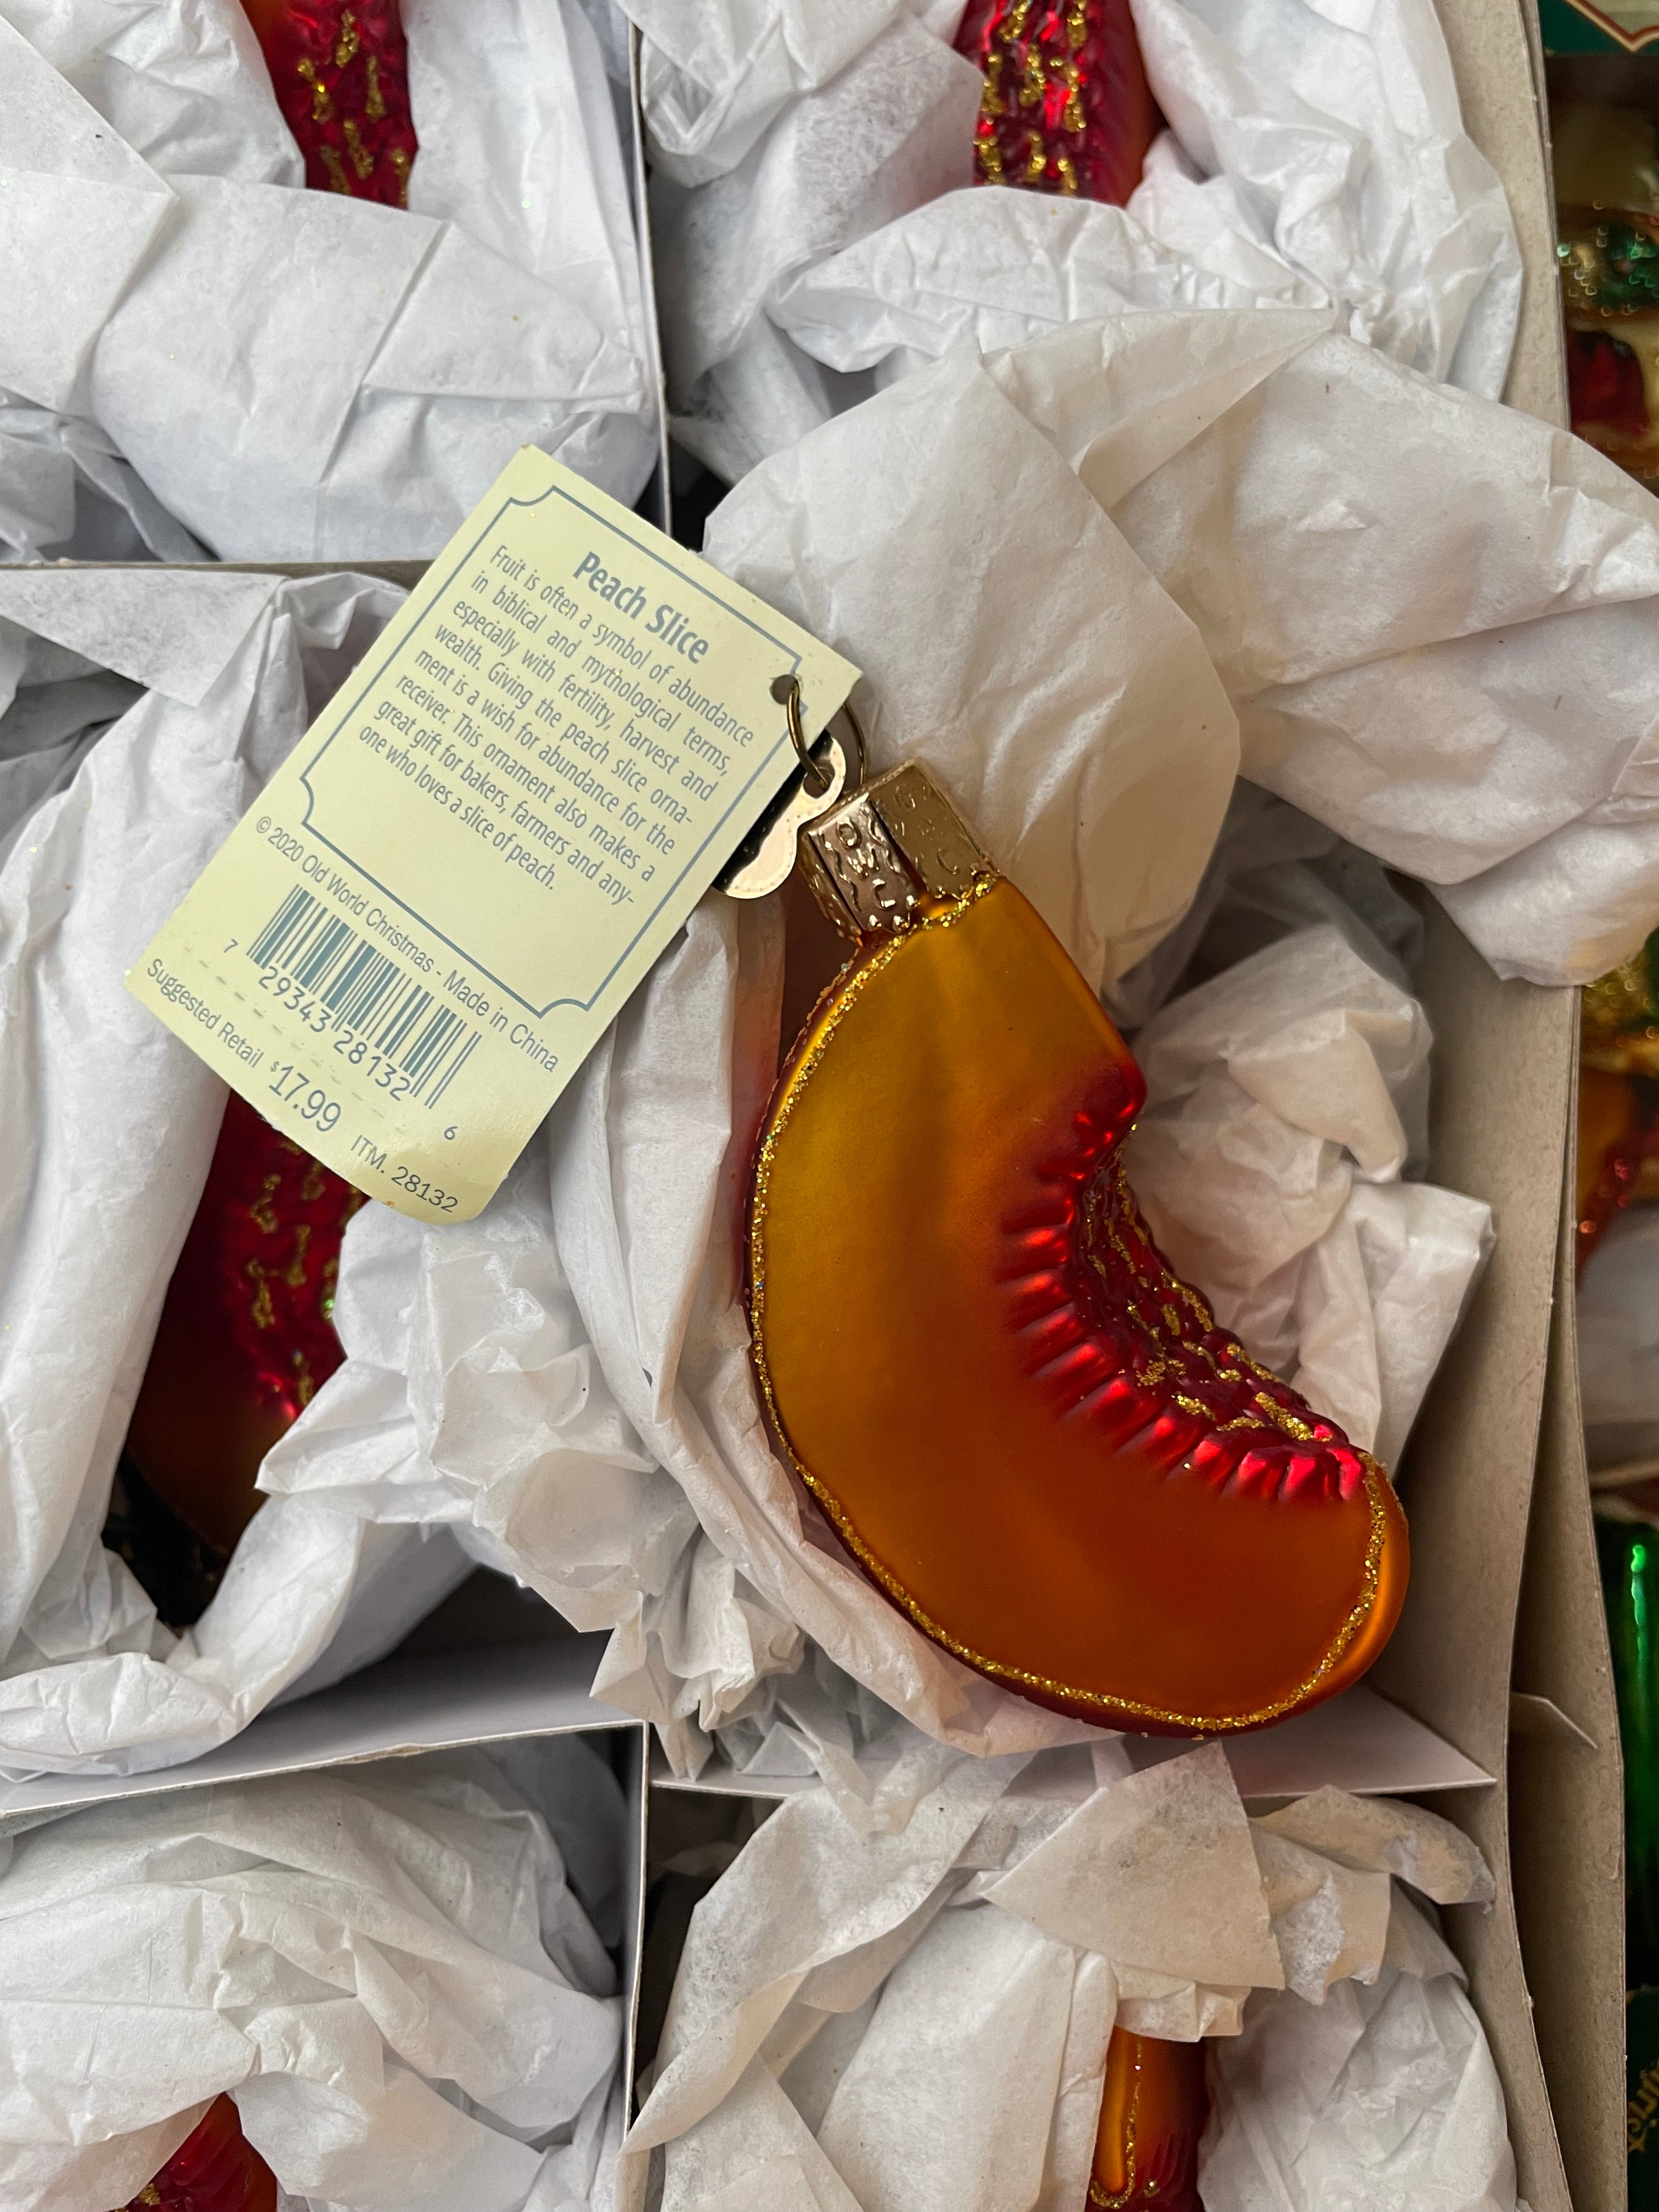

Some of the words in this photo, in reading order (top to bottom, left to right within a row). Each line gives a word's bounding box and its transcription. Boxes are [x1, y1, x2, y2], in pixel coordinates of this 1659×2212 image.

[470, 569, 489, 594] in
[491, 584, 548, 634] biblical
[546, 630, 582, 659] and
[580, 654, 682, 732] mythological
[682, 726, 730, 776] terms,
[489, 544, 526, 581] Fruit
[523, 569, 540, 591] is
[539, 585, 579, 620] often
[578, 613, 592, 630] a
[591, 623, 652, 670] symbol
[648, 663, 675, 684] of
[668, 677, 753, 748] abundance
[572, 550, 647, 620] Peach
[644, 603, 709, 664] Slice
[359, 726, 388, 754] one
[385, 744, 417, 776] who
[394, 674, 455, 725] receiver.
[452, 712, 483, 748] This
[483, 742, 556, 804] ornament
[554, 797, 588, 828] also
[588, 823, 641, 870] makes
[640, 864, 655, 882] a
[413, 764, 453, 805] loves
[414, 649, 455, 686] ment
[452, 673, 469, 696] is
[466, 689, 480, 707] a
[480, 698, 515, 733] wish
[514, 721, 541, 751] for
[538, 744, 619, 813] abundance
[619, 801, 647, 831] for
[645, 822, 675, 855] the
[434, 624, 483, 671] wealth.
[487, 661, 534, 710] Giving
[534, 697, 562, 728] the
[558, 722, 610, 764] peach
[610, 758, 647, 793] slice
[650, 788, 692, 824] orna-
[452, 600, 520, 657] especially
[521, 648, 556, 683] with
[557, 673, 615, 731] fertility,
[618, 718, 680, 775] harvest
[680, 769, 719, 802] and
[373, 701, 417, 736] great
[408, 728, 442, 756] gift
[437, 743, 464, 772] for
[459, 759, 509, 814] bakers,
[510, 799, 572, 856] farmers
[566, 848, 605, 880] and
[598, 872, 634, 905] any-
[449, 797, 462, 814] a
[459, 804, 494, 839] slice
[492, 831, 518, 851] of
[504, 843, 555, 890] peach.
[267, 826, 304, 862] 2020
[301, 854, 331, 883] Old
[326, 872, 370, 916] World
[365, 907, 435, 973] Christmas
[442, 969, 490, 1017] Made
[488, 1006, 509, 1032] in
[509, 1023, 558, 1073] China
[146, 957, 222, 1030] Suggested
[217, 1021, 264, 1068] Retail
[268, 1060, 341, 1132] $17.99
[223, 938, 239, 953] 7
[257, 965, 332, 1032] 29343
[332, 1029, 415, 1102] 28132
[443, 1125, 458, 1141] 6
[350, 1133, 387, 1173] ITM.
[390, 1165, 458, 1213] 28132
